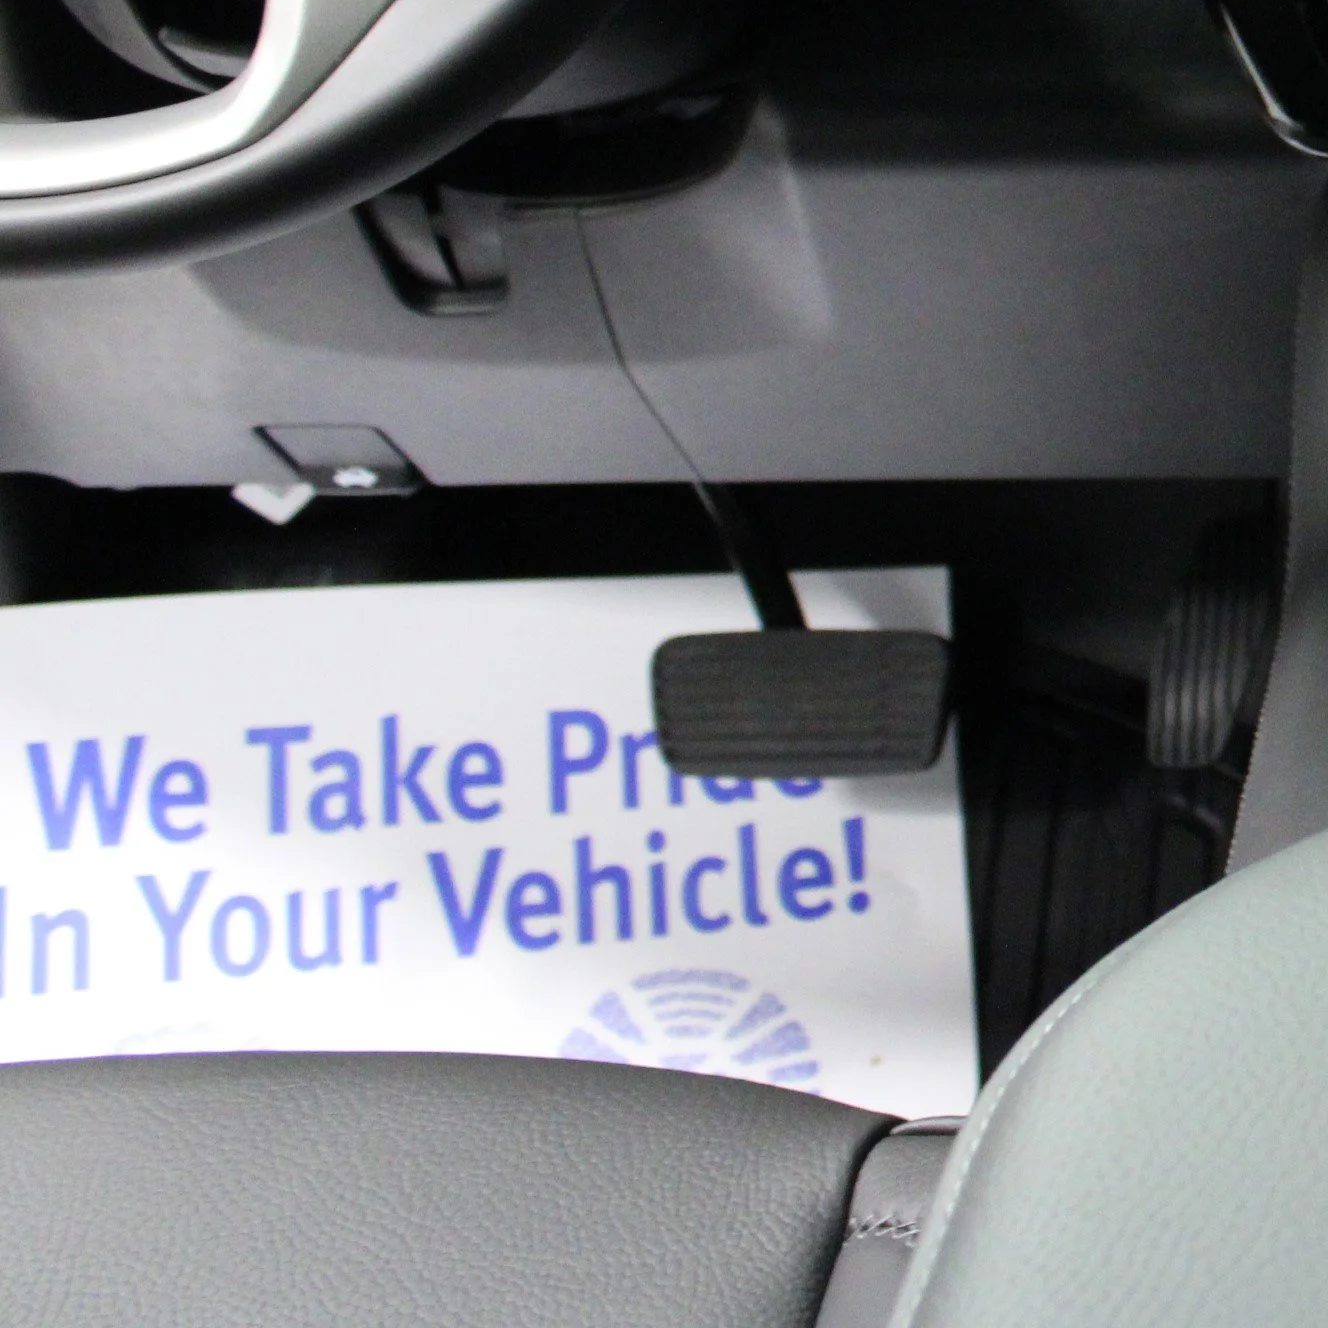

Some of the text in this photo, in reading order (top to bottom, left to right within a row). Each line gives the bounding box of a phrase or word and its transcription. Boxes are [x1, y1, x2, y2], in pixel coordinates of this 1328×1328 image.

[28, 734, 211, 851] We
[246, 714, 505, 836] Take
[137, 870, 399, 984] Your
[427, 816, 872, 959] Vehicle!
